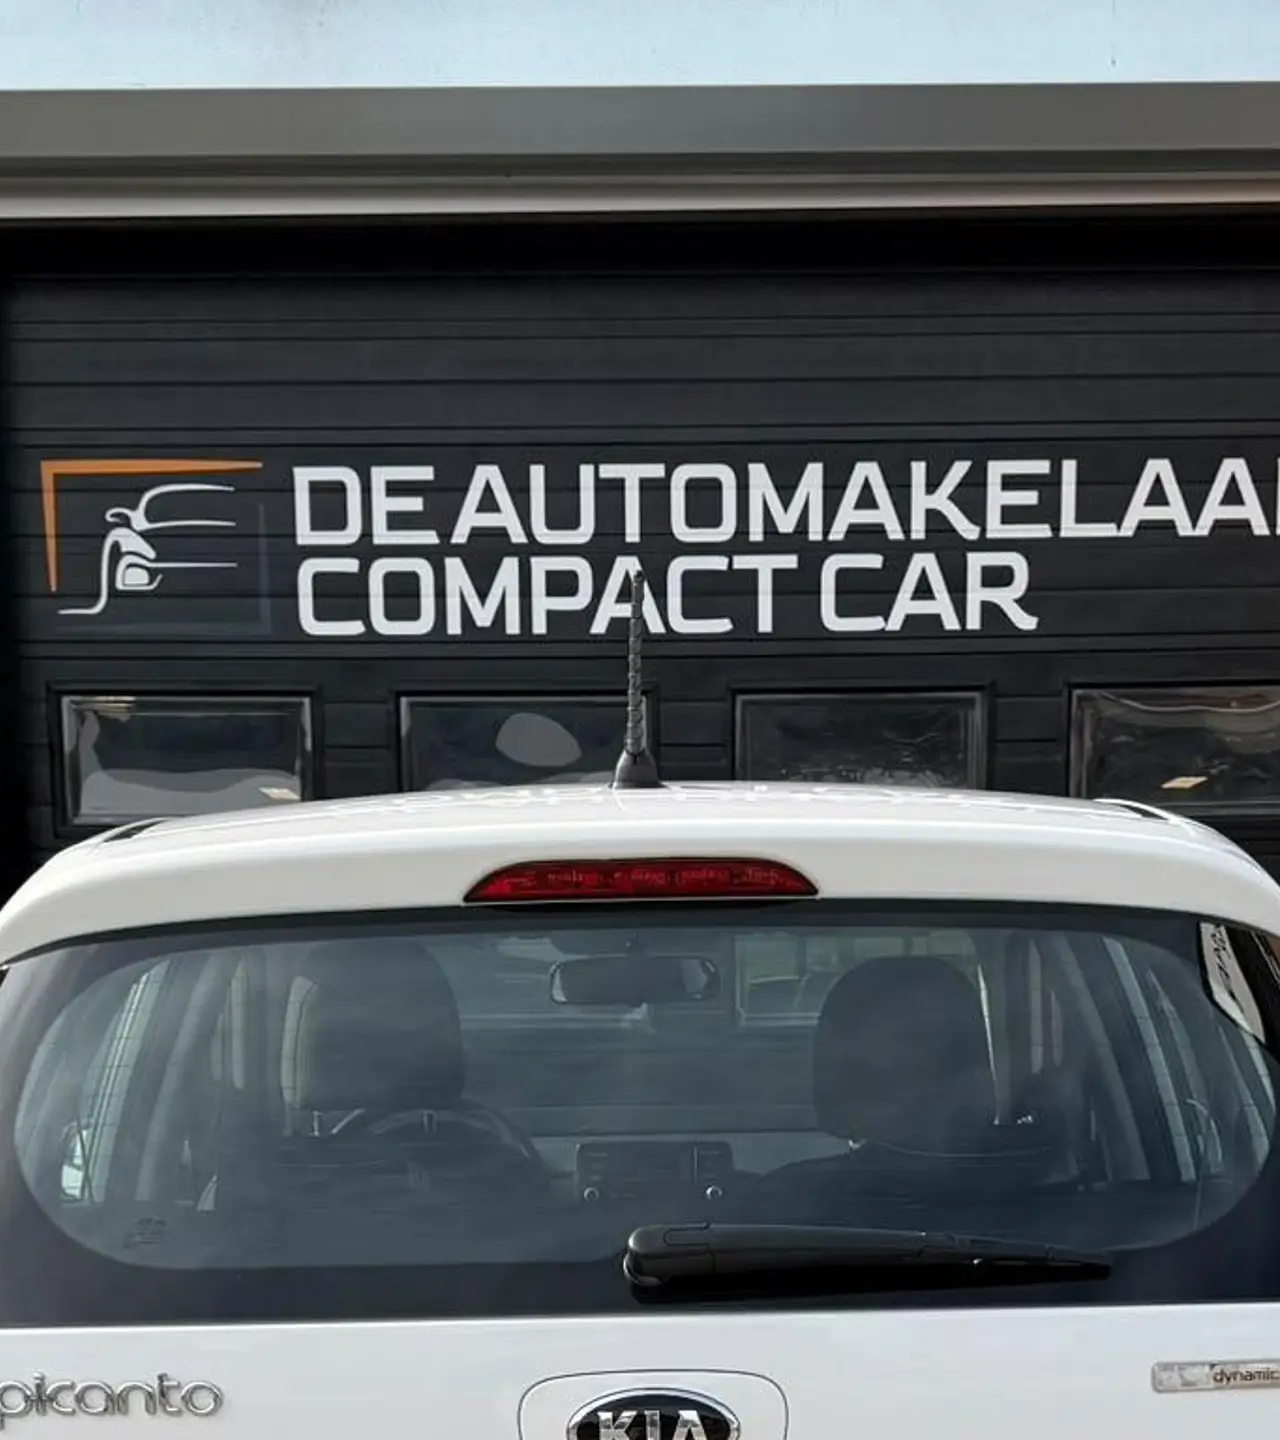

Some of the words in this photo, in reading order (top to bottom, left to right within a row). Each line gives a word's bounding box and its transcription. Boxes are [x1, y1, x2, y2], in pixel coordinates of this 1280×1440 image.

[292, 464, 440, 546] DE
[296, 554, 812, 638] COMPACT
[818, 550, 1040, 631] CAR
